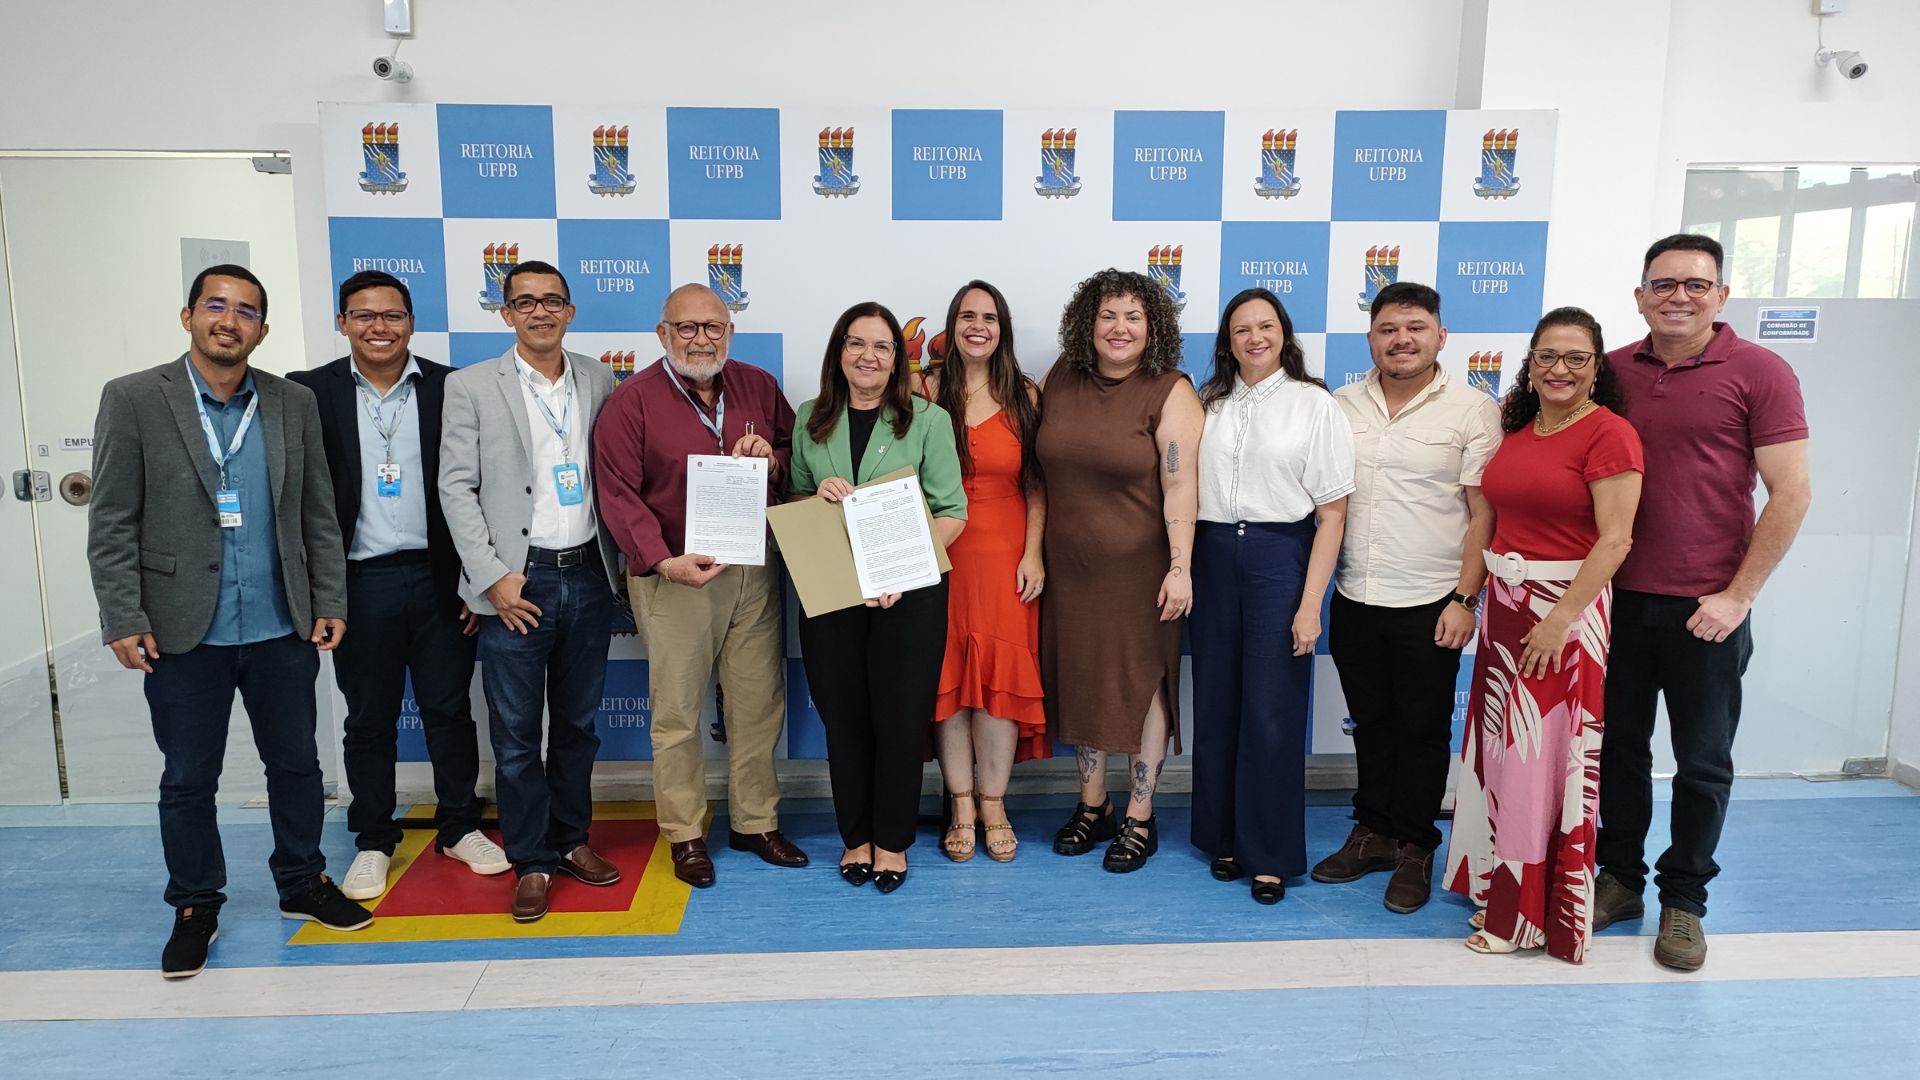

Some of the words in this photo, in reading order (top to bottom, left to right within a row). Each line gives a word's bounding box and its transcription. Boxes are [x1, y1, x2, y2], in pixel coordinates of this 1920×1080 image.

[461, 144, 533, 158] REITORIA
[690, 145, 760, 160] REITORIA
[914, 147, 982, 161] REITORIA
[1135, 148, 1203, 162] REITORIA
[1355, 148, 1423, 162] REITORIA
[479, 163, 517, 178] UFPB
[706, 165, 743, 179] UFPB
[929, 166, 966, 180] UFPB
[1149, 167, 1187, 181] UFPB
[1370, 167, 1406, 181] UFPB
[352, 258, 425, 273] REITORIA
[580, 260, 651, 275] REITORIA
[1241, 261, 1308, 275] REITORIA
[1457, 261, 1525, 276] REITORIA
[597, 278, 635, 293] UFPB
[1256, 279, 1293, 293] UFPB
[1472, 280, 1508, 294] UFPB
[64, 438, 96, 447] EMPU
[599, 697, 650, 711] EITORI
[608, 714, 645, 728] UFPB
